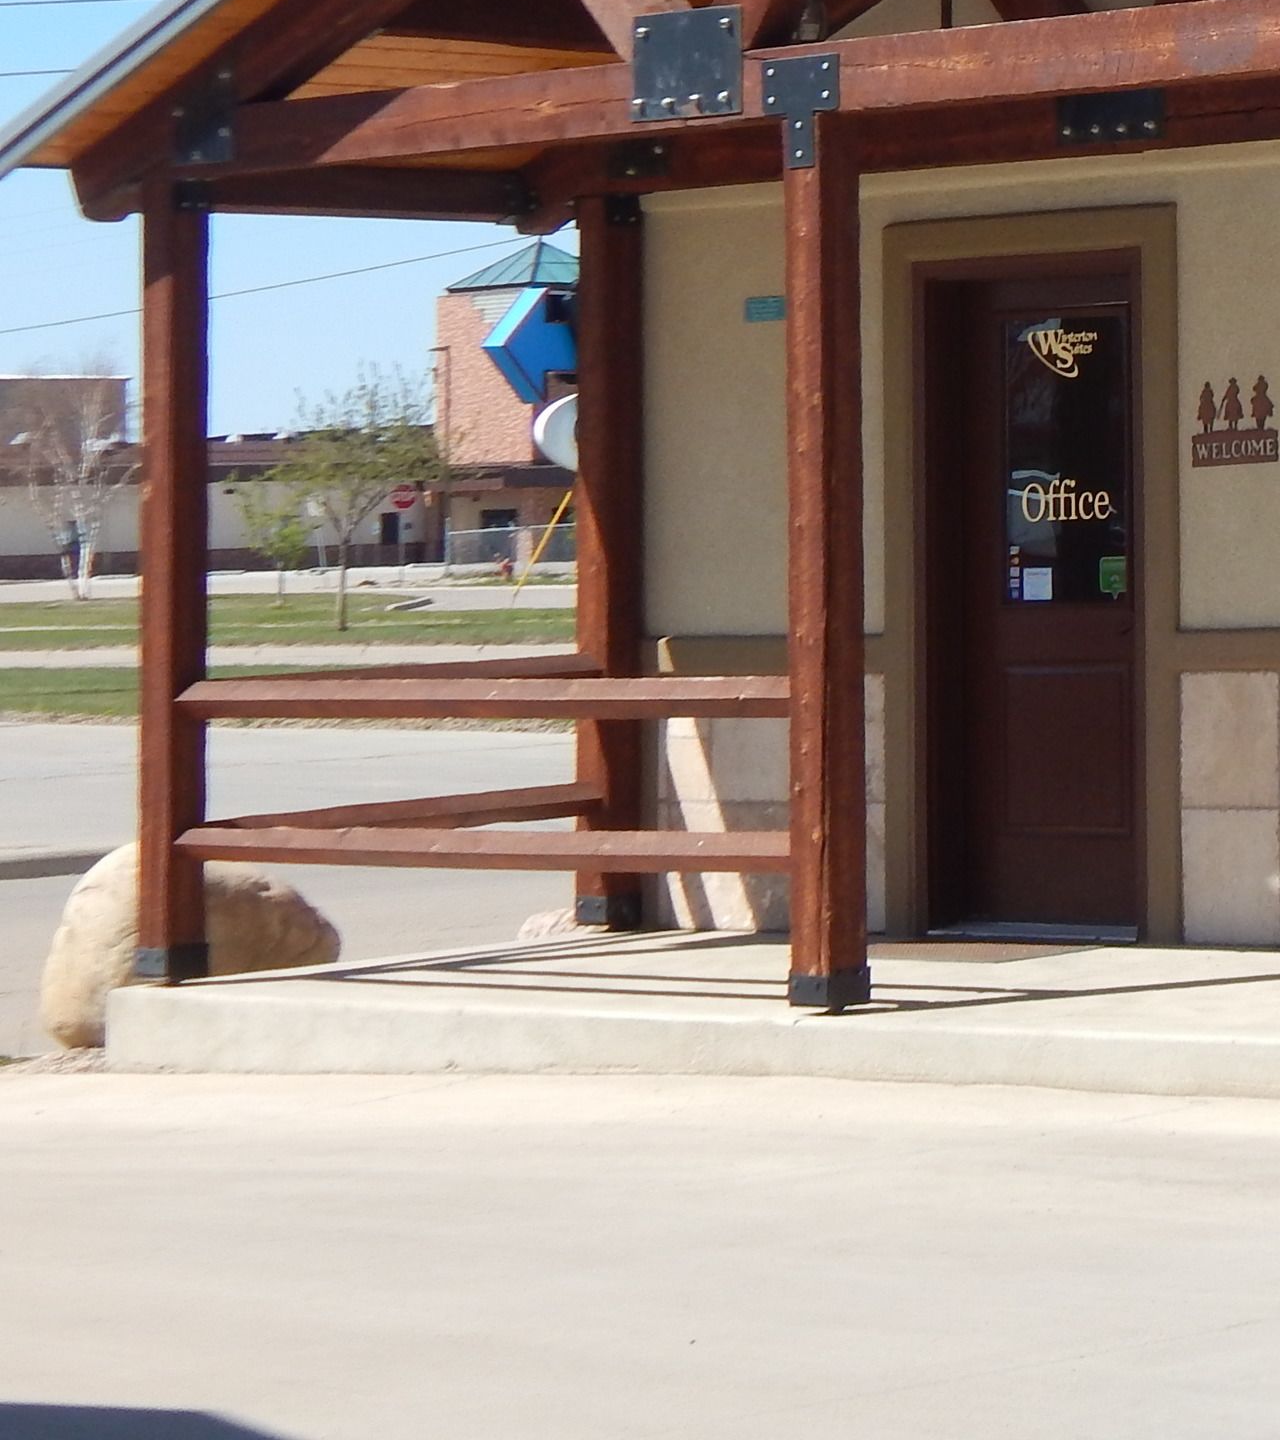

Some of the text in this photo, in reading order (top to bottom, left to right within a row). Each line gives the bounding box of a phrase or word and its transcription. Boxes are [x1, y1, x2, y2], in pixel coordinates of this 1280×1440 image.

[1056, 342, 1093, 368] Suites
[1196, 438, 1276, 460] WELCOME
[1021, 478, 1111, 523] Office
